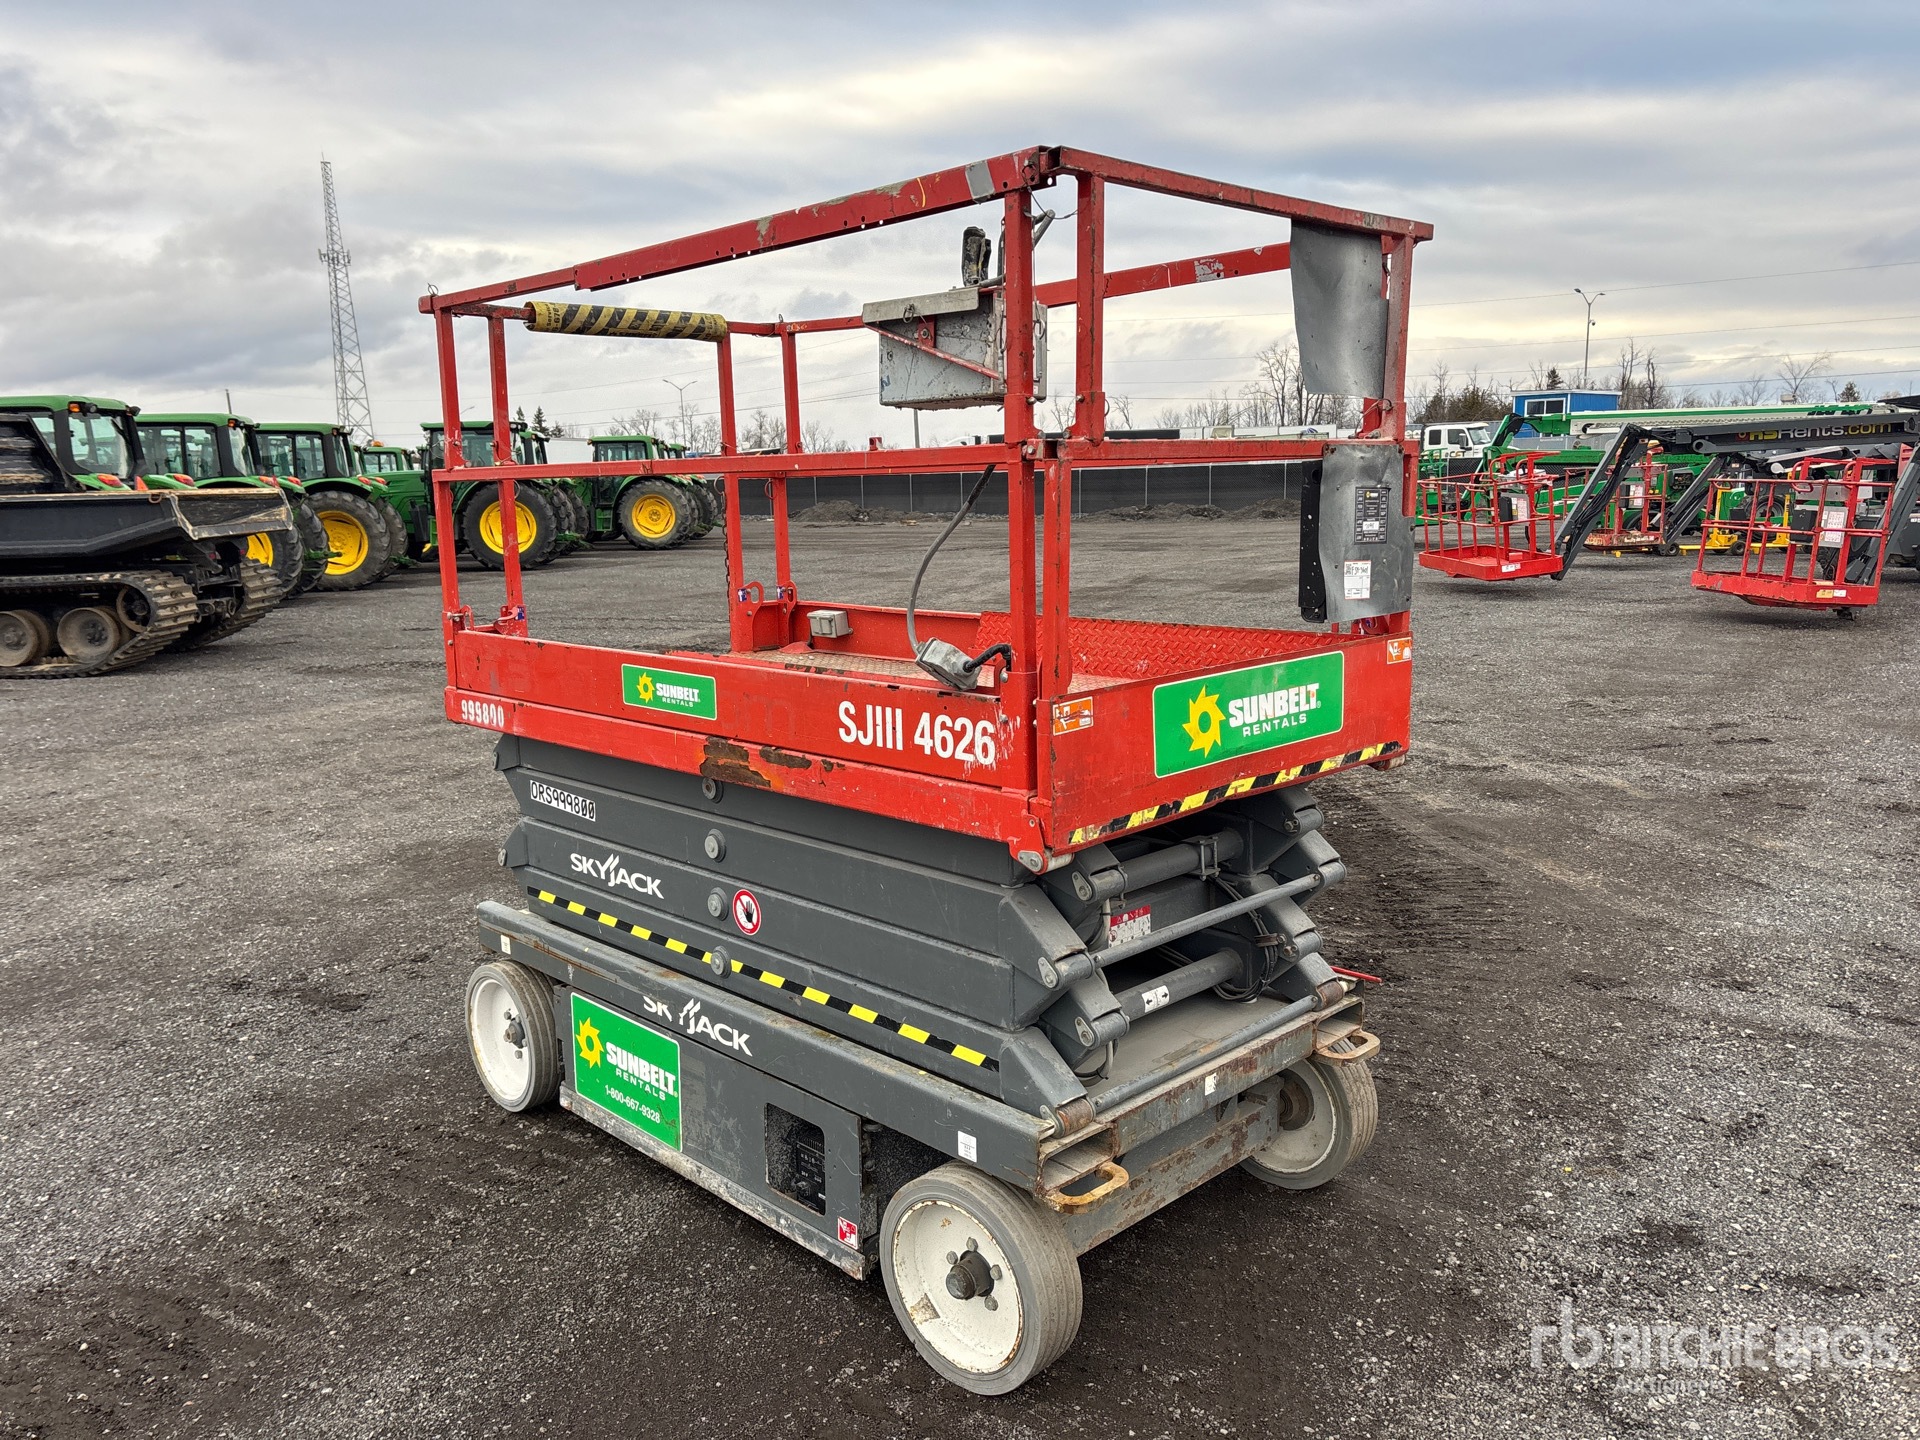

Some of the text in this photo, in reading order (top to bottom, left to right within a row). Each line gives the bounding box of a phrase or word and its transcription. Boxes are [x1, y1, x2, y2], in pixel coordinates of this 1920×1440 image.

[656, 682, 700, 702] SUNBELT
[662, 697, 694, 708] RENTALS
[1228, 682, 1320, 727] SUNBELT
[461, 700, 504, 728] 999800
[1242, 713, 1307, 737] RENTALS
[913, 711, 996, 766] 4626
[530, 781, 596, 821] ORS999800
[570, 852, 665, 900] SKYJACK
[643, 995, 753, 1057] SKYJACK
[606, 1041, 676, 1096] SUNBELT
[615, 1069, 666, 1101] RENTALS
[604, 1084, 661, 1124] 1-800-667-9328
